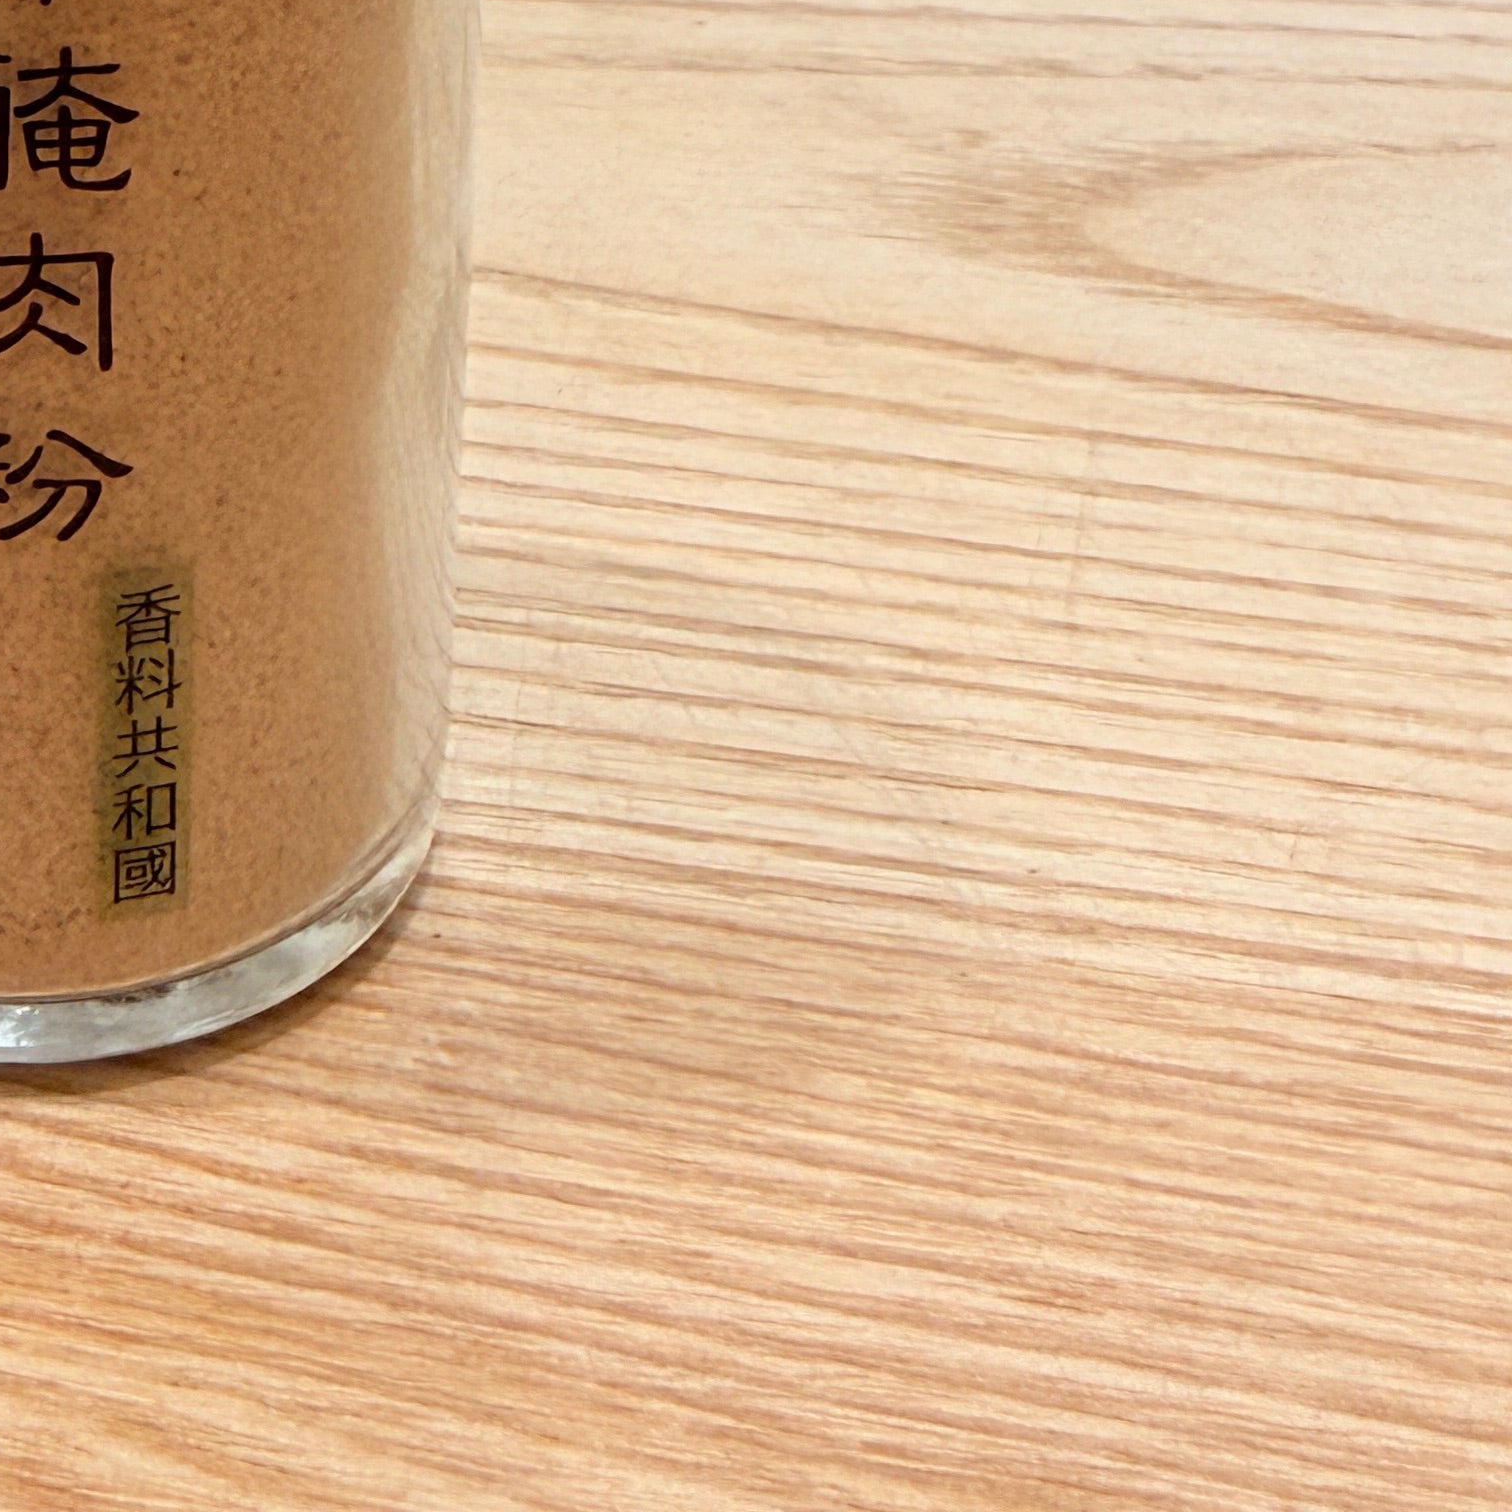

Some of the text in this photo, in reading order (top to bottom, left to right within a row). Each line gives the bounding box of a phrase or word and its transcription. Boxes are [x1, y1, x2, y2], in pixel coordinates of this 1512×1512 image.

[111, 583, 183, 904] 香料共和國
